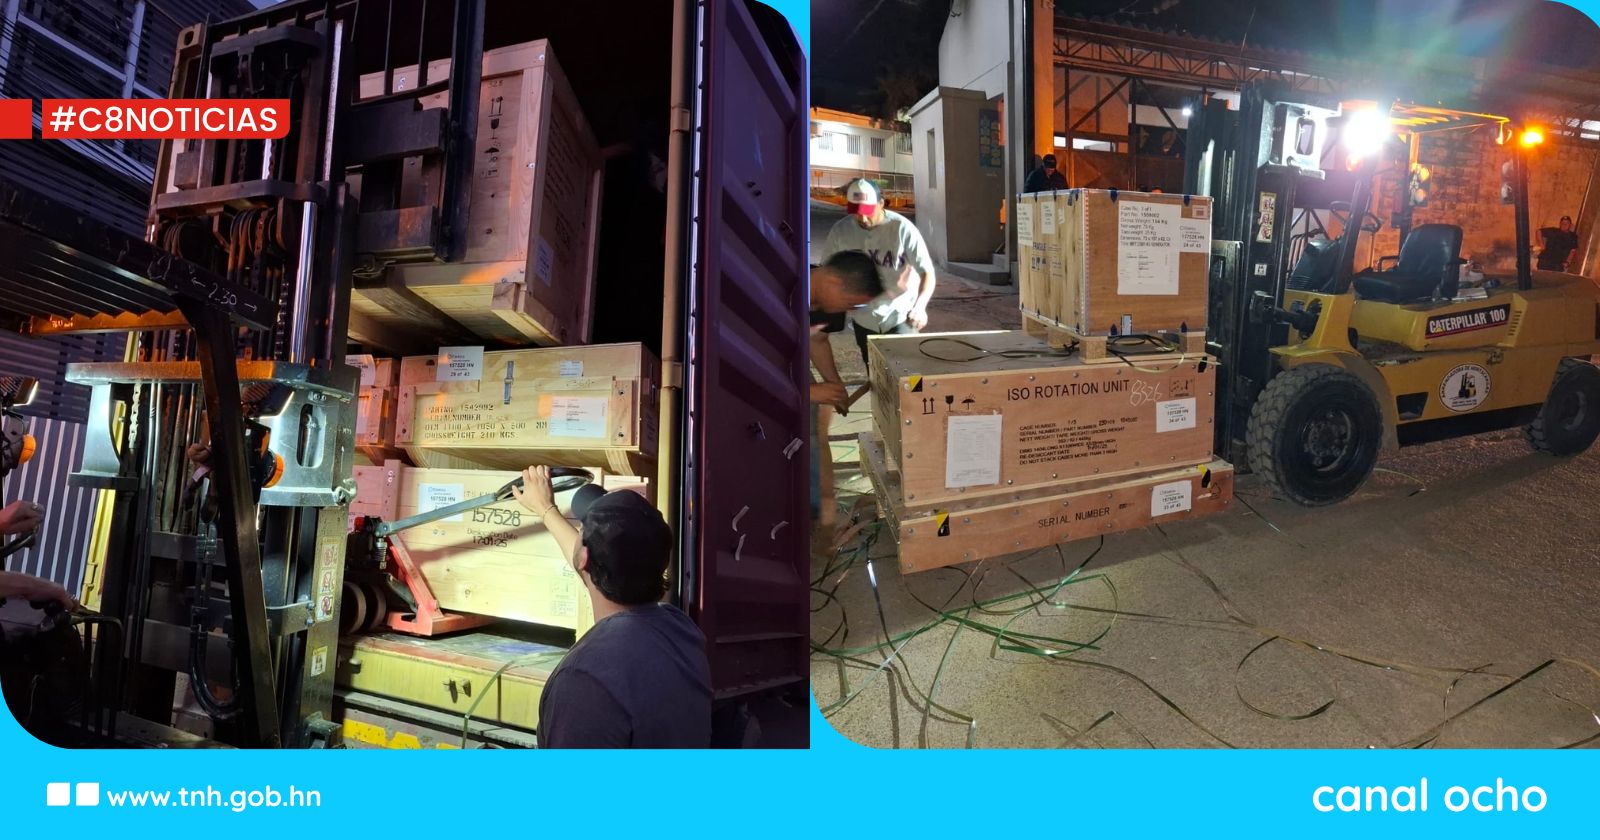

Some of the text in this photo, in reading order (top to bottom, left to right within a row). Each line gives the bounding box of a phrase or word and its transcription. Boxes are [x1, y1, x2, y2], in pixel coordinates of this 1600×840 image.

[1429, 308, 1506, 333] CATERPILLAR 100
[1007, 379, 1130, 401] ISO ROTATION UNIT
[472, 508, 521, 527] 157528
[1038, 515, 1071, 529] SERIAL
[1075, 506, 1110, 522] NUMBER
